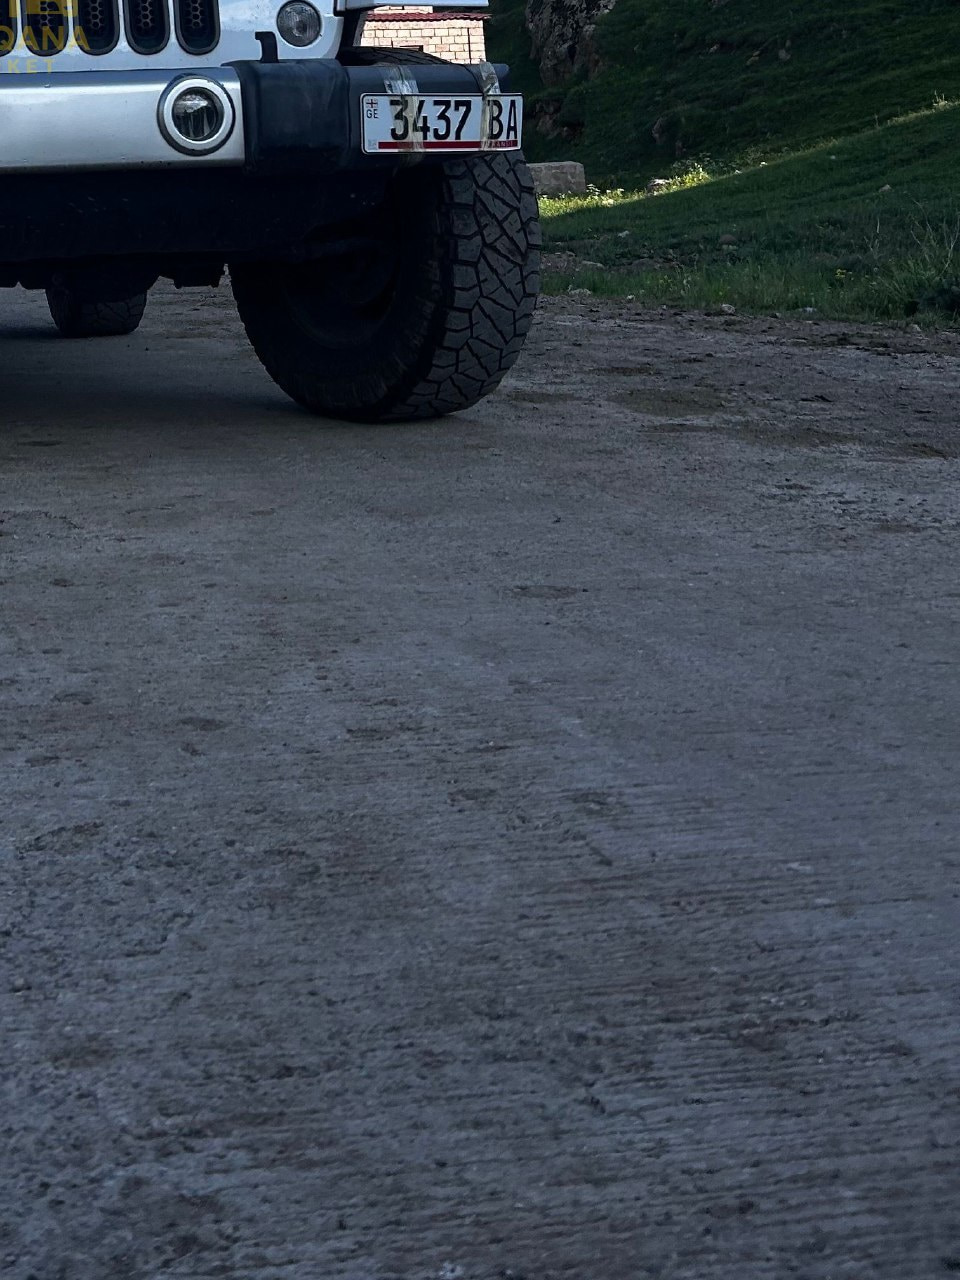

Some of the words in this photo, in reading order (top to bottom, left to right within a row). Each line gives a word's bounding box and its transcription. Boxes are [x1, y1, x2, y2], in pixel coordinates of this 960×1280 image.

[366, 108, 379, 119] GE
[390, 99, 472, 141] 3437
[488, 99, 518, 140] BA
